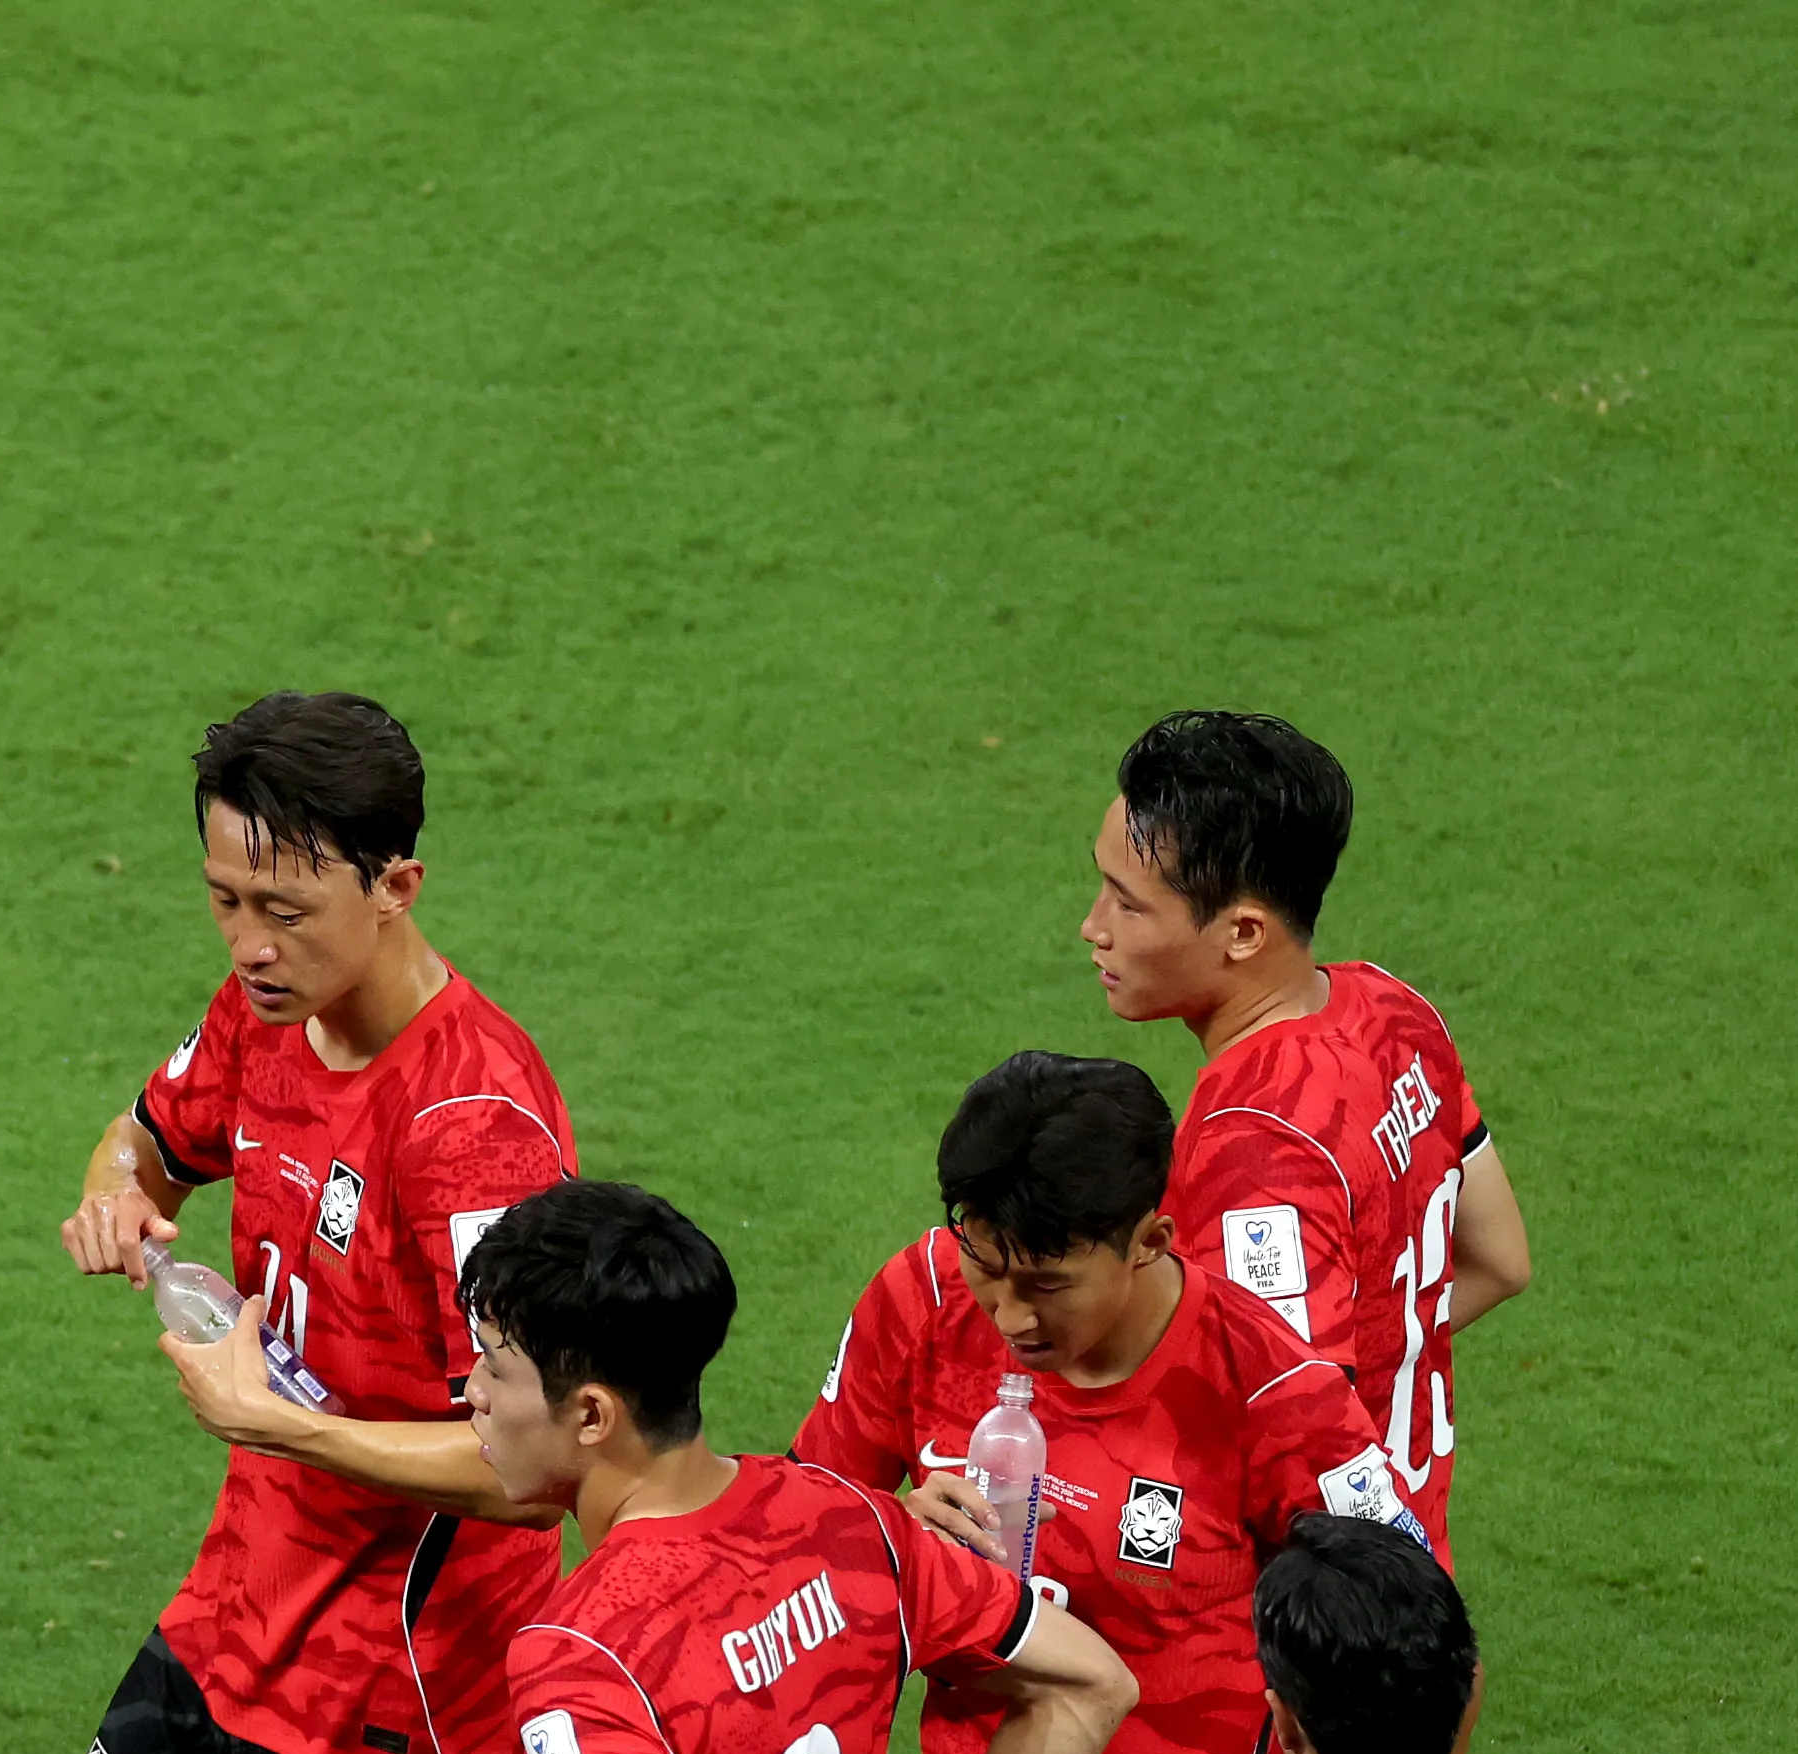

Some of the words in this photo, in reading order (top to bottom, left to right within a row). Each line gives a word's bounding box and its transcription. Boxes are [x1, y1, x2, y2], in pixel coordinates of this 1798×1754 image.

[1243, 1248, 1266, 1265] Unite
[1266, 1246, 1281, 1261] For
[1247, 1262, 1282, 1280] PEACE
[1256, 1280, 1275, 1288] FIFA
[1043, 1473, 1067, 1488] EPUBLIC
[1073, 1483, 1099, 1499] CZECHIA
[1065, 1497, 1089, 1511] MEXICO
[1355, 1499, 1384, 1519] PEACE
[1019, 1474, 1040, 1585] martwater
[1114, 1567, 1174, 1589] KOREA
[721, 1569, 847, 1693] GIHYUK
